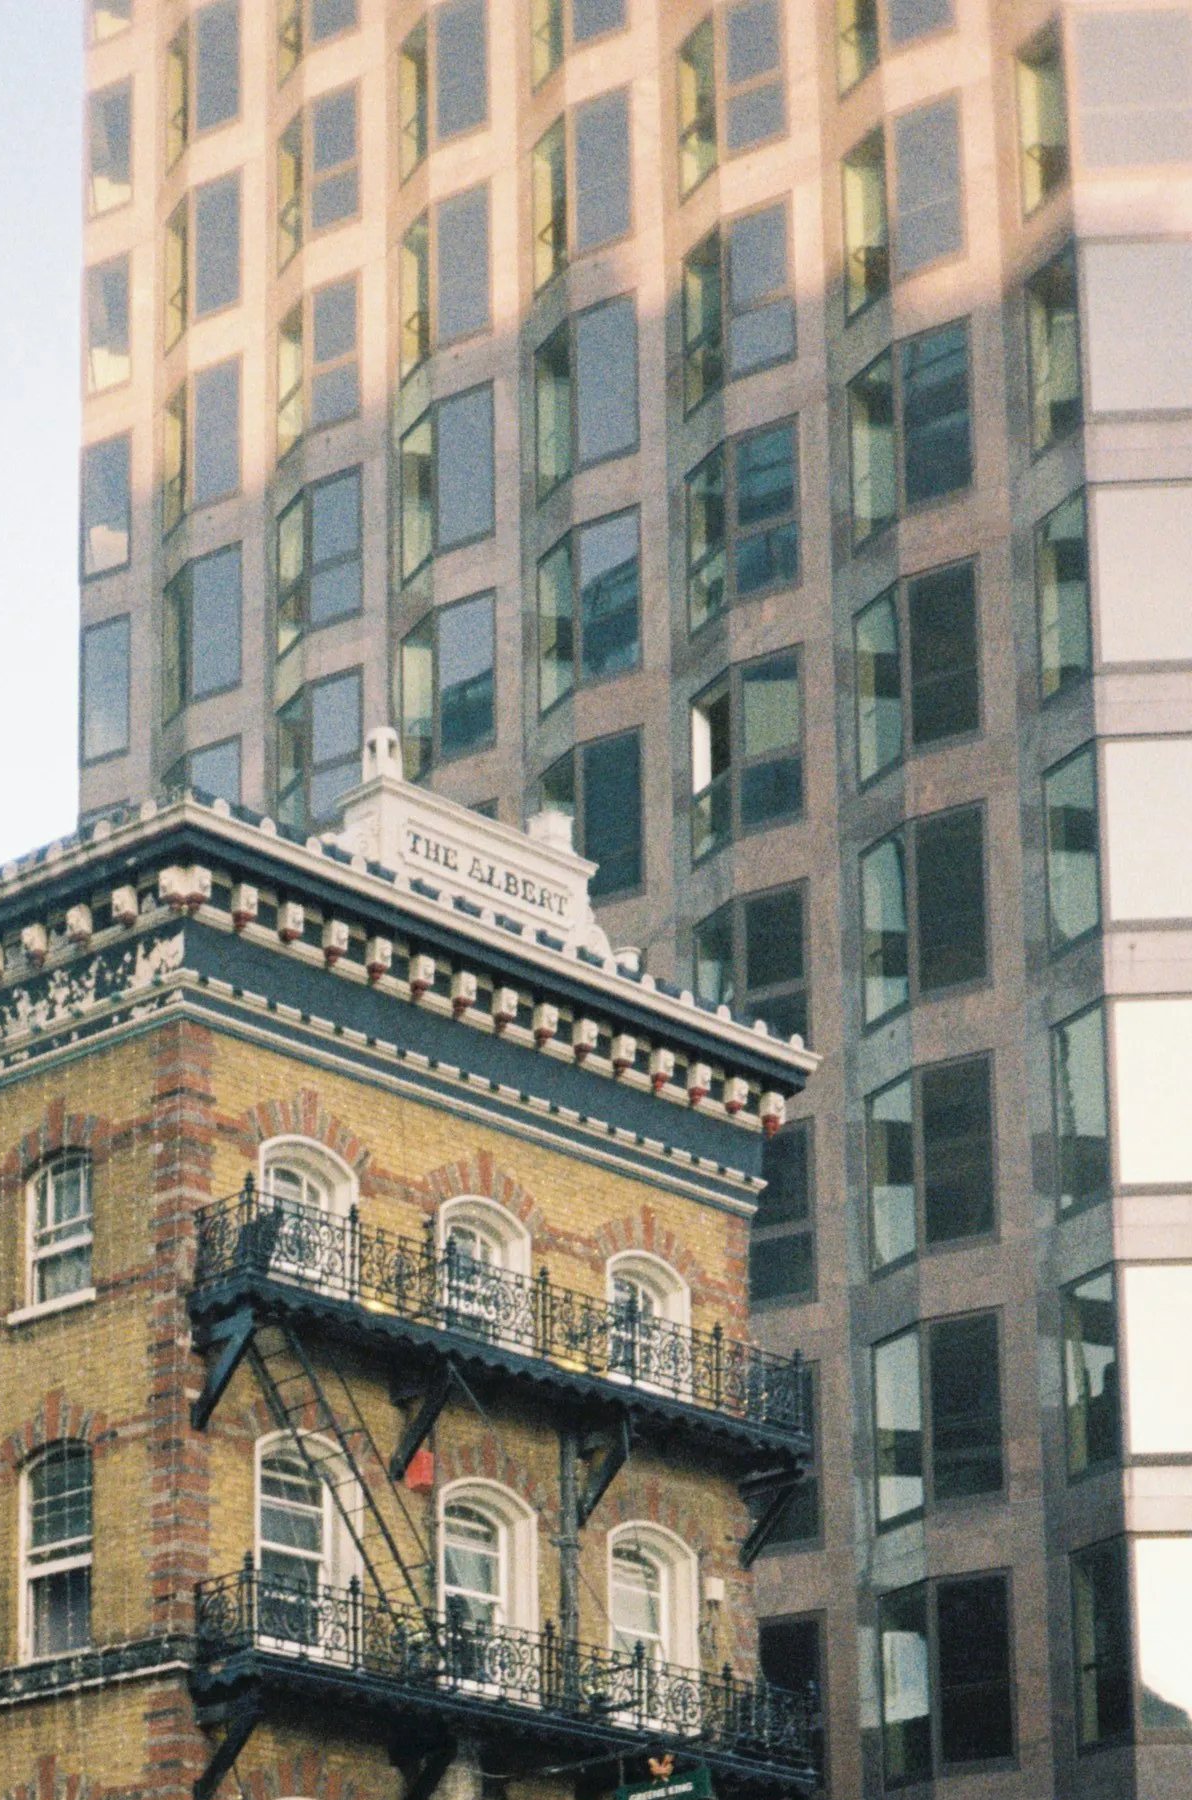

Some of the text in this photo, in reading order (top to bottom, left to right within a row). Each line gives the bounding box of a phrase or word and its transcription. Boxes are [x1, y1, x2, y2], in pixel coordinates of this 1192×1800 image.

[407, 830, 568, 916] THE ALBERT
[668, 1782, 693, 1795] KING
